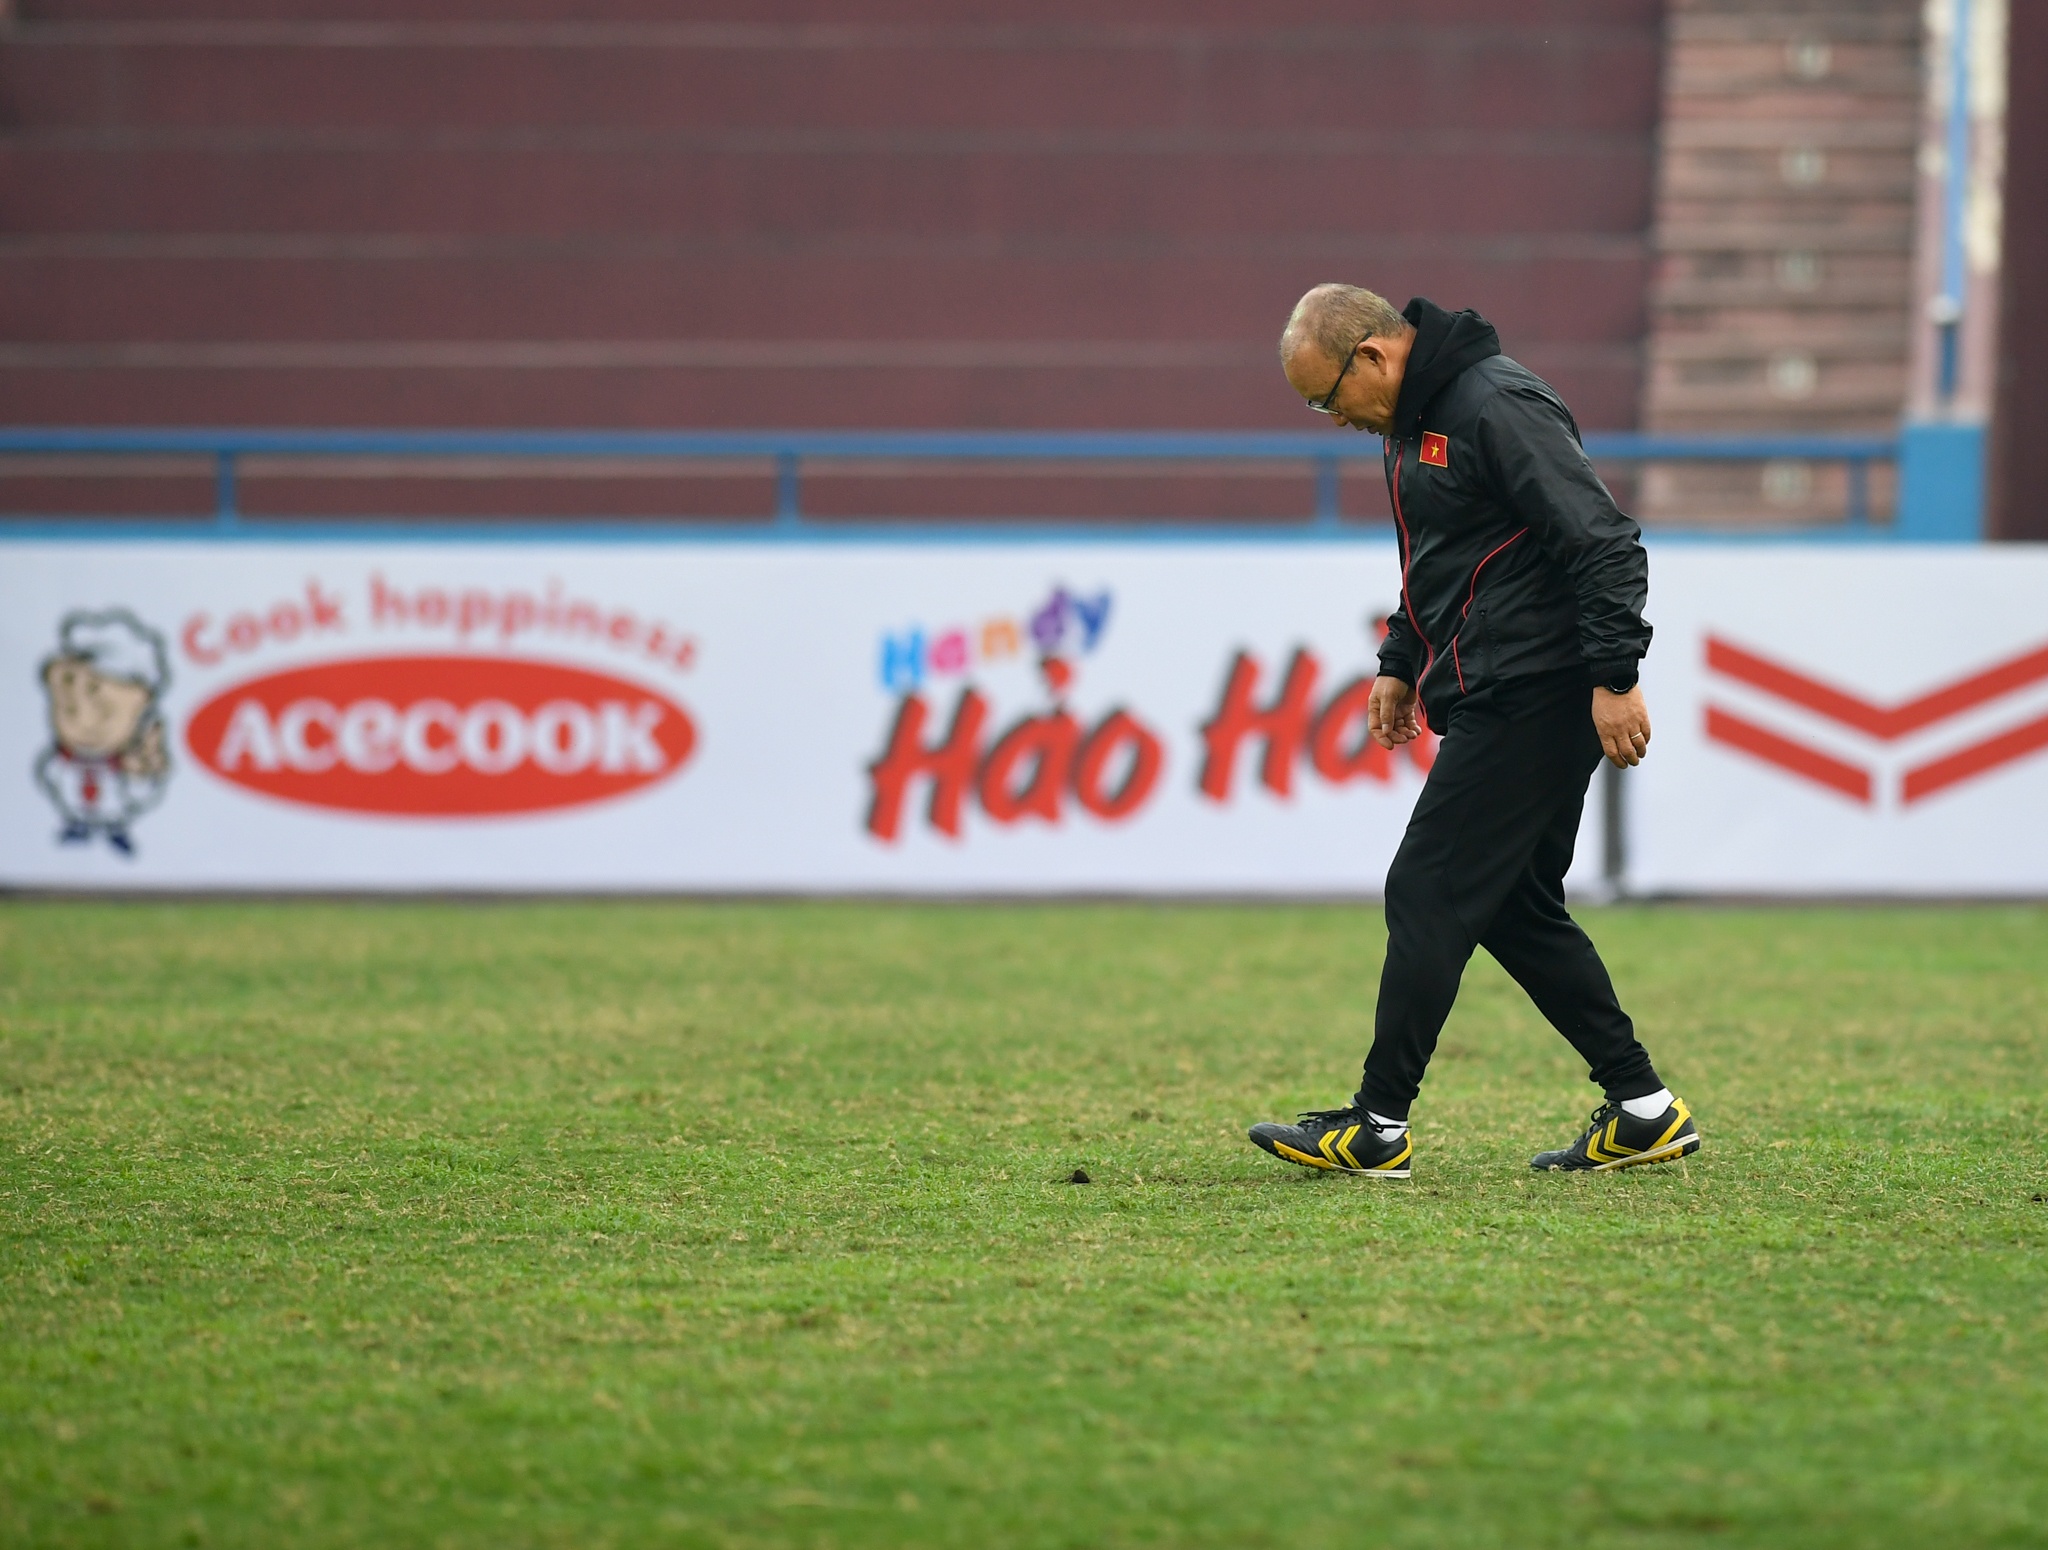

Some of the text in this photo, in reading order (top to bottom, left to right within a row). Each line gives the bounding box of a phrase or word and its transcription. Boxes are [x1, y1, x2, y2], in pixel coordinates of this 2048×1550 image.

[182, 581, 342, 664] Cook
[879, 583, 1114, 694] Handy
[866, 656, 1167, 845] Hảo
